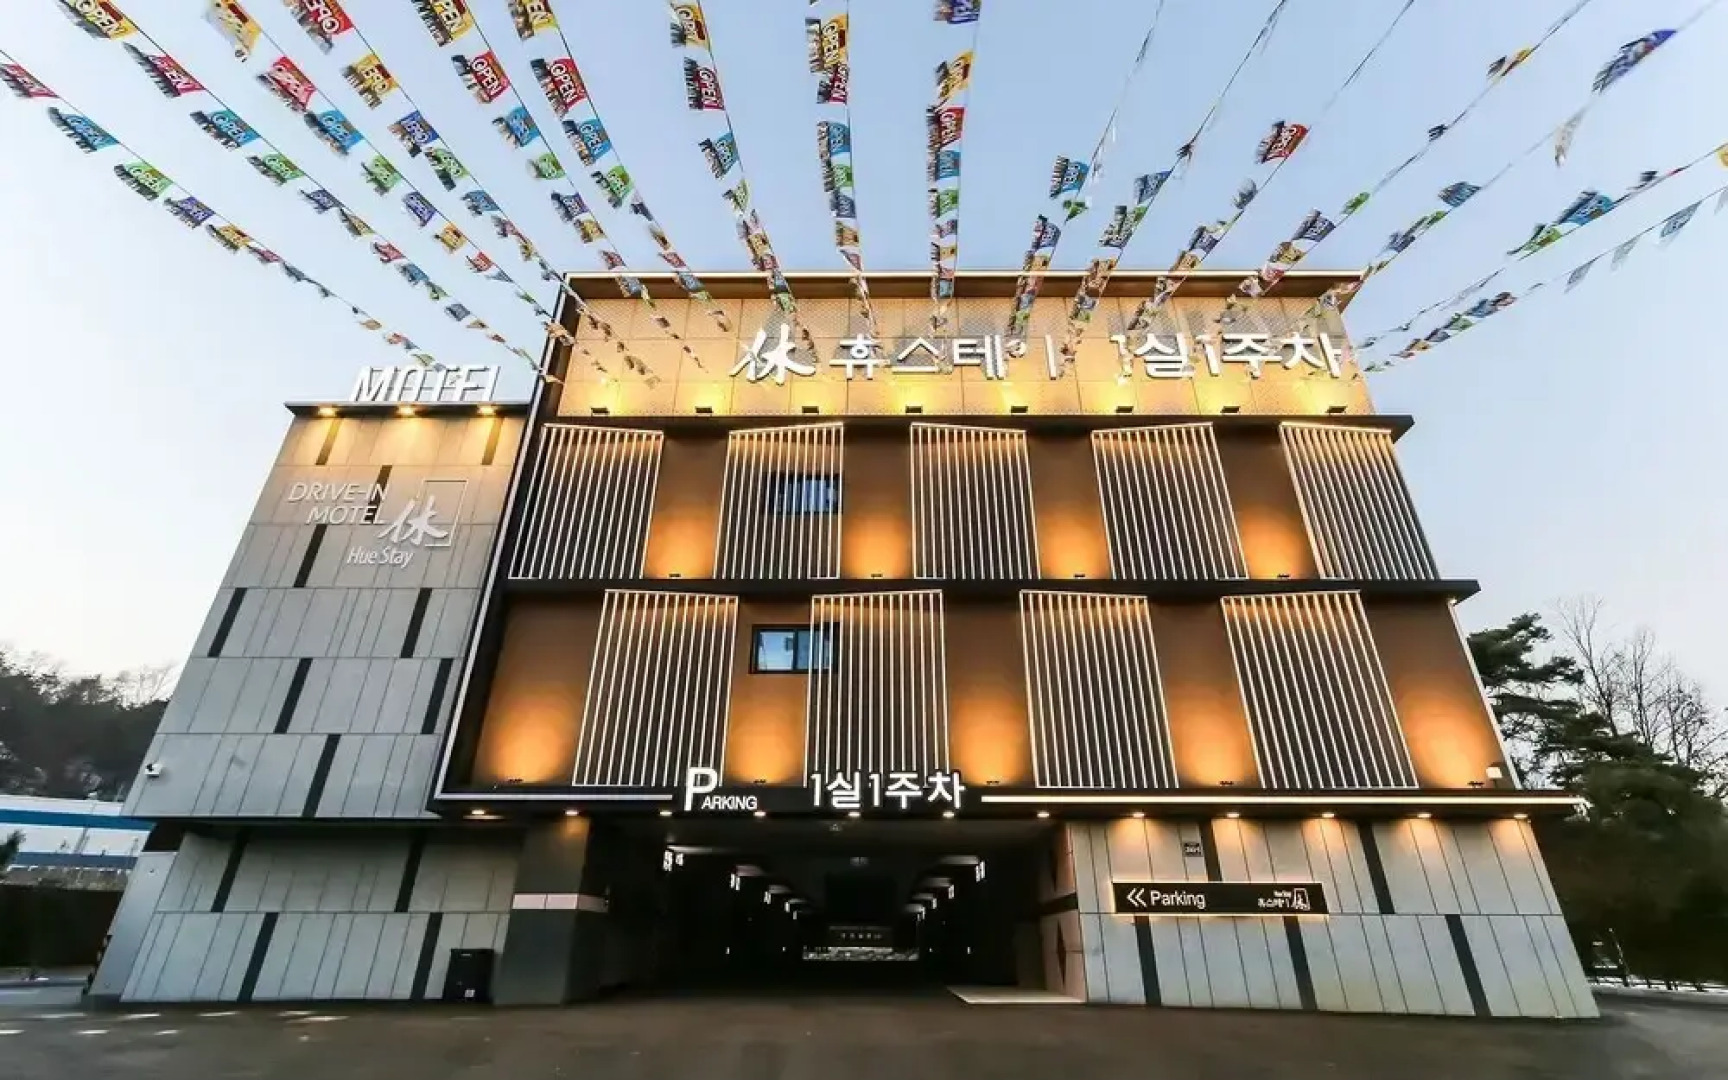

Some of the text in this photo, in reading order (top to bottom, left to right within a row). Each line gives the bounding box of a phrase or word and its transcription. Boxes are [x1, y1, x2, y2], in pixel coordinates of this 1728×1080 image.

[440, 0, 465, 33] PEN
[471, 57, 504, 97] OPEN
[550, 63, 581, 104] OPEN
[212, 112, 249, 144] OPEN
[729, 323, 1342, 385] 休 휴스테이 1실1주차
[350, 365, 501, 401] MOTEL
[288, 482, 391, 503] DRIVE-IN
[305, 505, 387, 525] MOTEL
[377, 494, 449, 546] 休
[347, 547, 414, 568] Hue Stay
[683, 766, 758, 811] PARKING
[809, 770, 966, 810] 1실1주차
[1150, 890, 1206, 909] Parking
